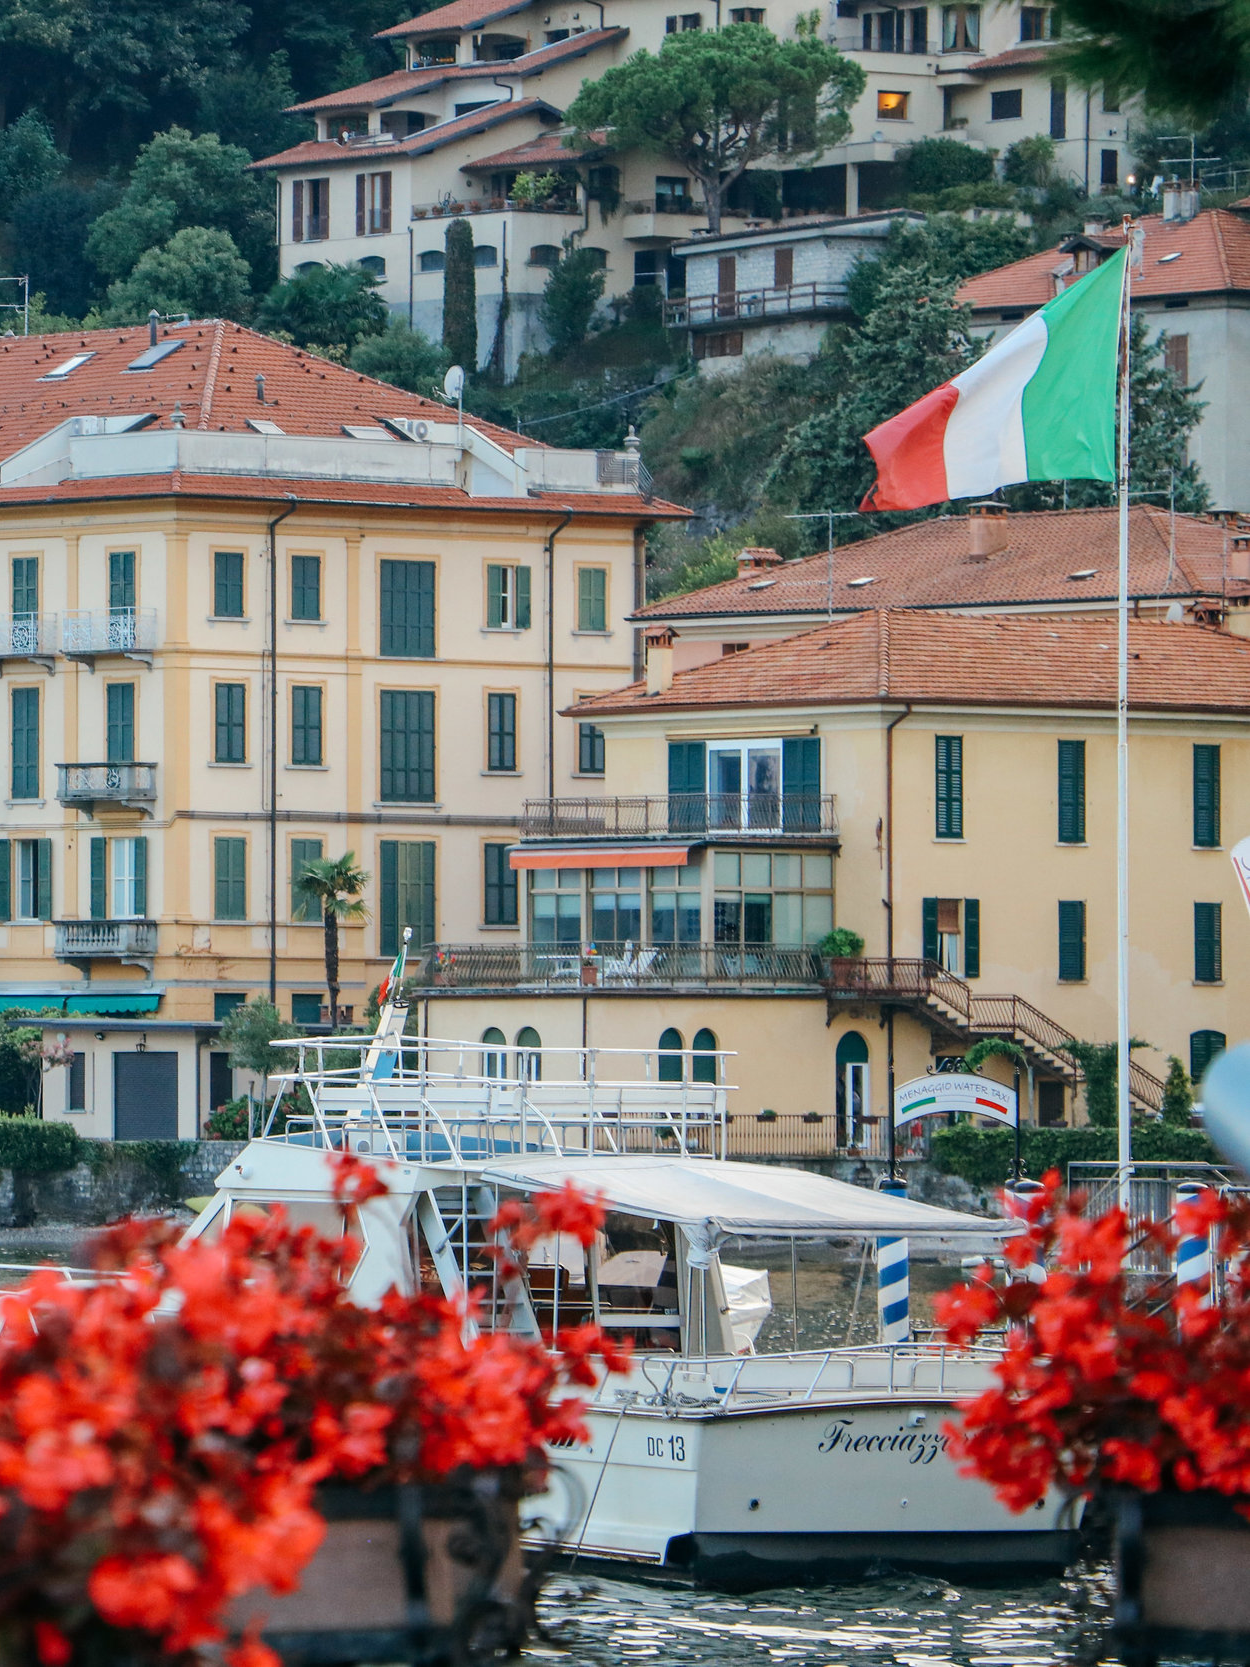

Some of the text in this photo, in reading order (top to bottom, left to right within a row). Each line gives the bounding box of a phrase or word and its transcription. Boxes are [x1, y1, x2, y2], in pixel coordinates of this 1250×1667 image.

[899, 1082, 1011, 1103] MENAGGIO WATER TAXI
[647, 1434, 686, 1462] DC 13
